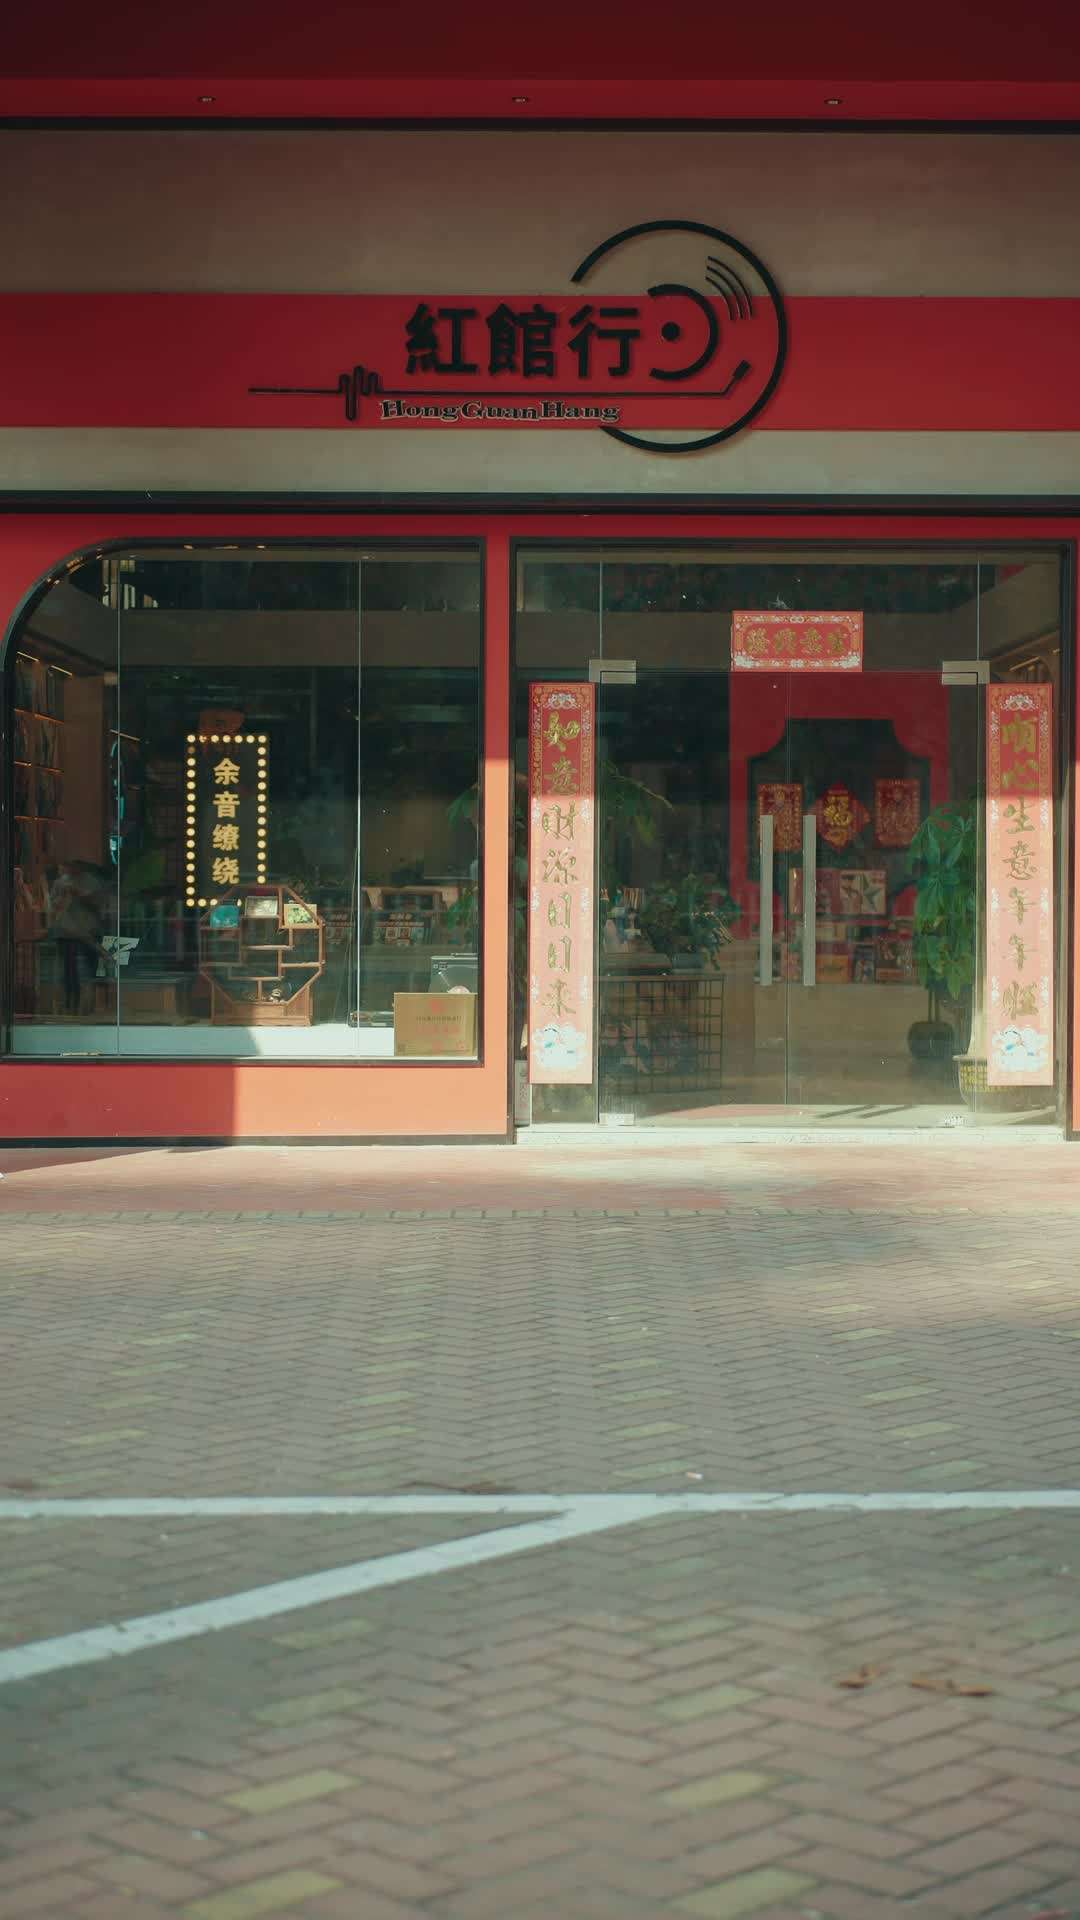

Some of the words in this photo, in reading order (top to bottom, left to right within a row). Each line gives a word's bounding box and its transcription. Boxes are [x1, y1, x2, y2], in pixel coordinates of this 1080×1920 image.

[405, 303, 641, 378] 紅館行
[380, 399, 620, 422] HongGuanHang
[212, 757, 241, 885] 余音缭绕
